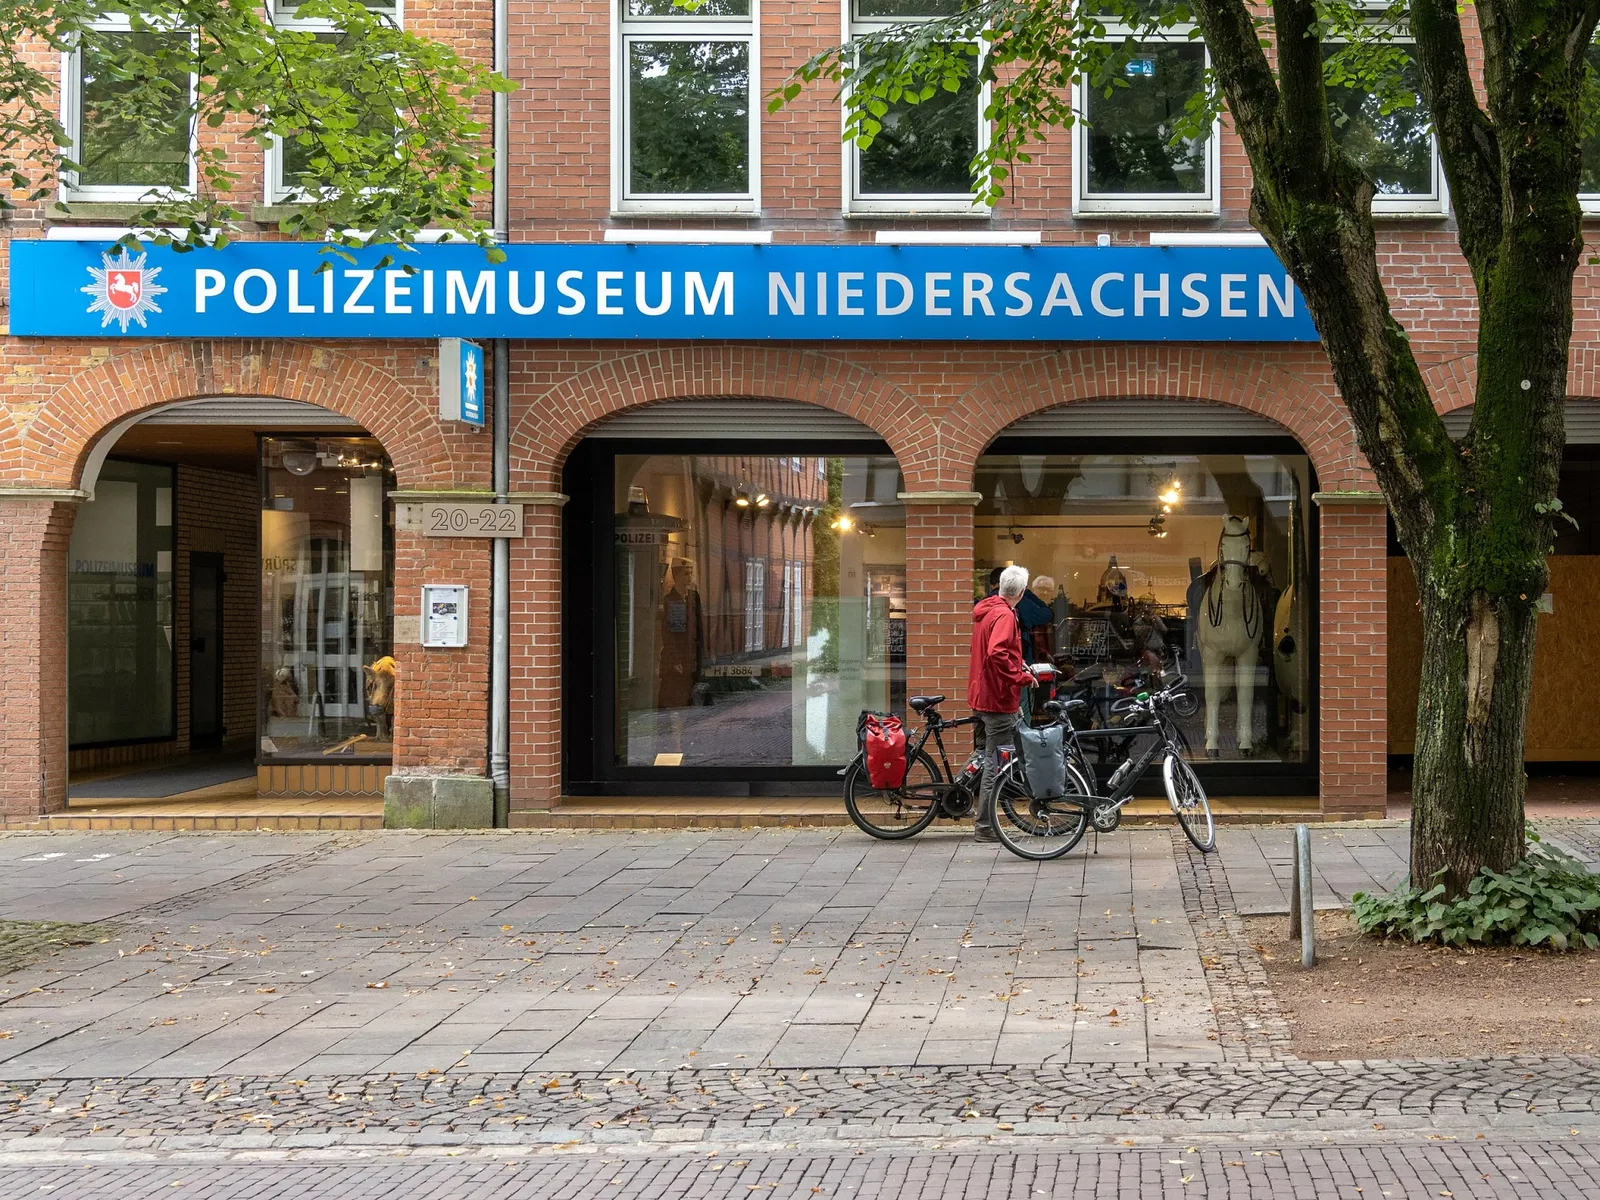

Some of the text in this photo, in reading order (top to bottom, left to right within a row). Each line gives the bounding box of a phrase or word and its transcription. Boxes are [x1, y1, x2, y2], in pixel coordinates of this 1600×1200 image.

[194, 267, 1296, 319] POLIZEIMUSEUM NIEDERSACHSEN
[430, 507, 517, 532] 20-22
[613, 532, 656, 544] POLIZEI
